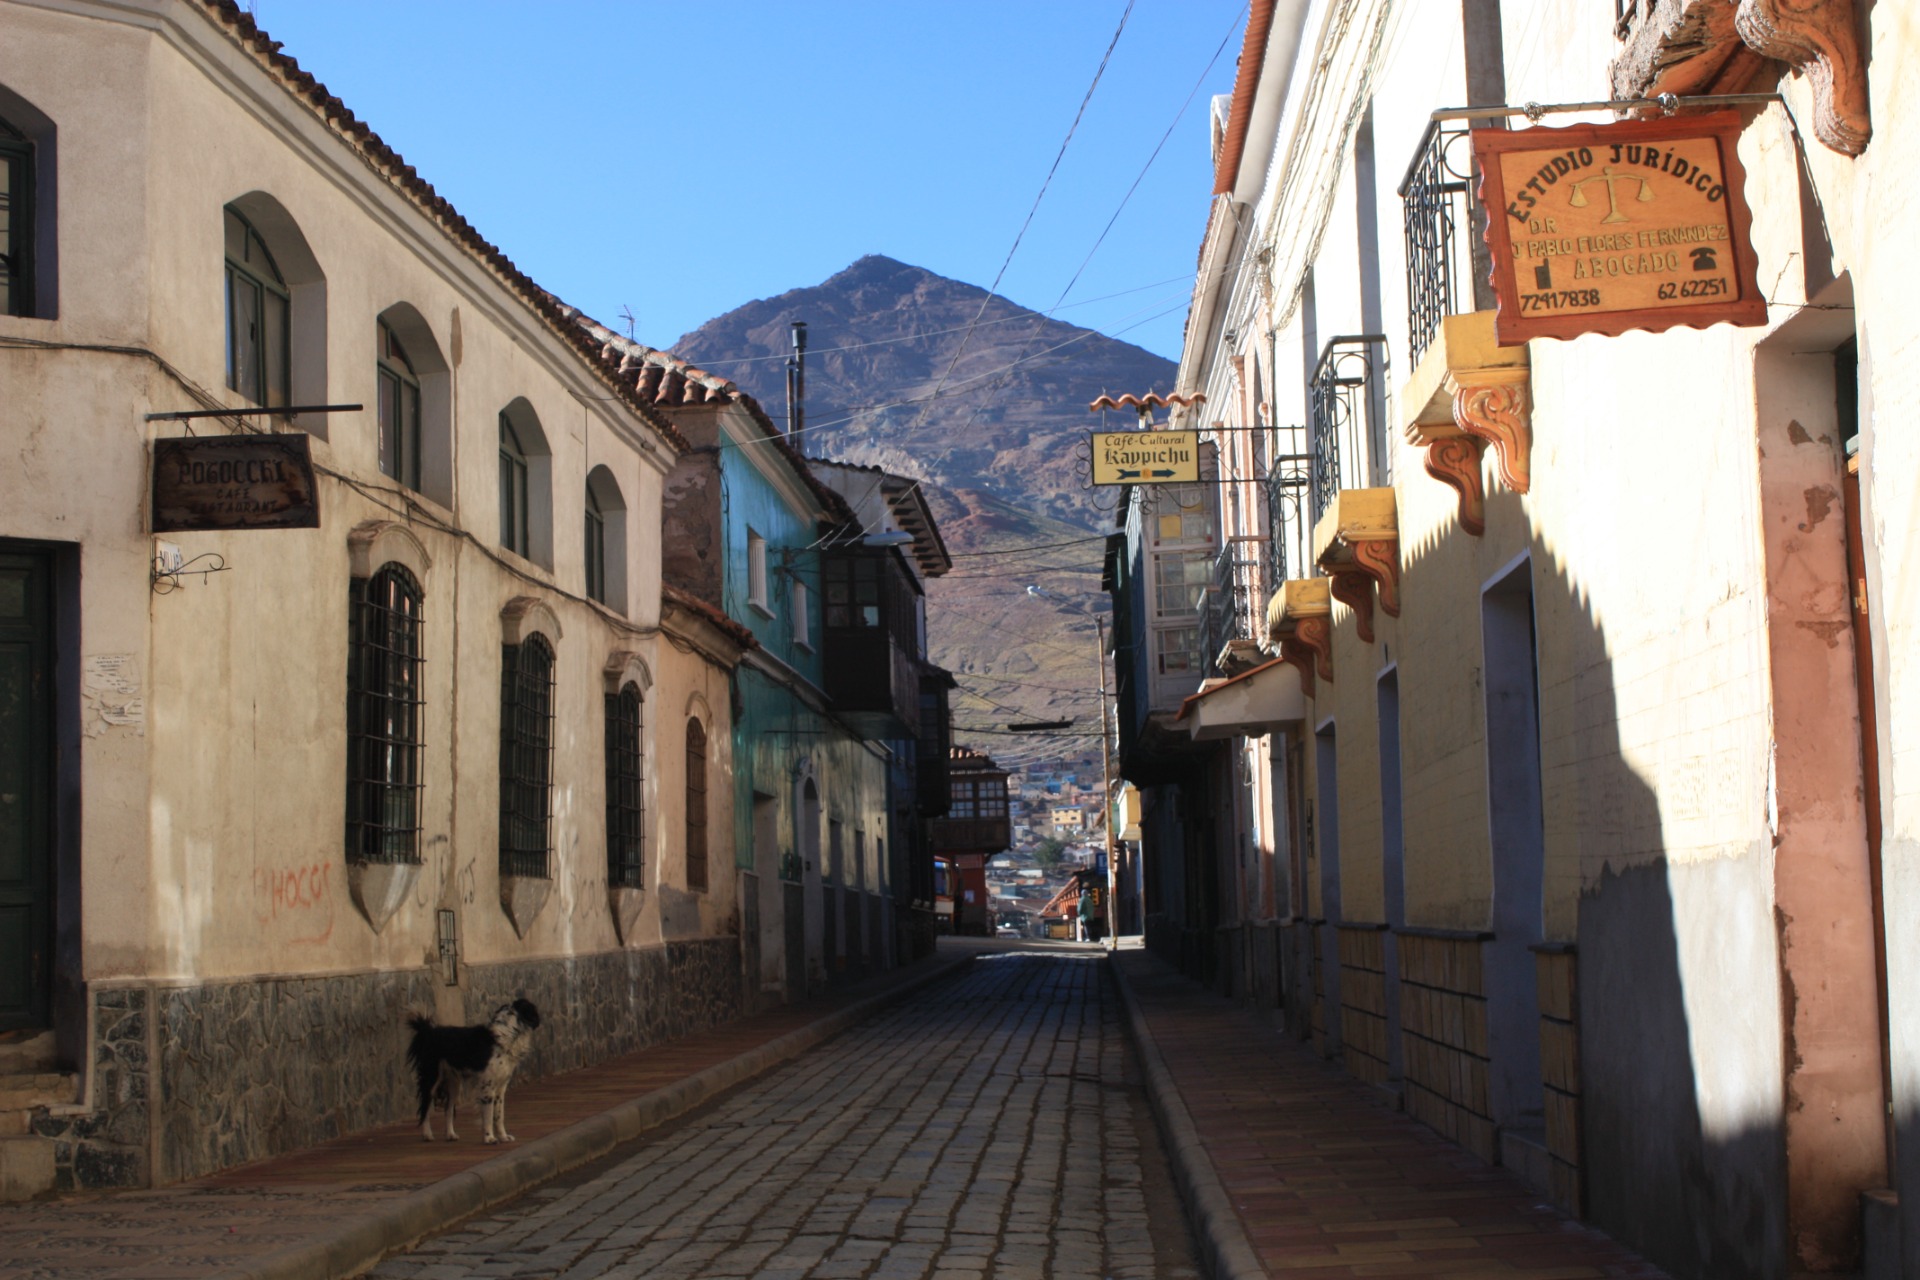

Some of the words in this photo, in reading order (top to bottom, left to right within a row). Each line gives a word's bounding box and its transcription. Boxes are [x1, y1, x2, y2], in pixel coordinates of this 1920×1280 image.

[1507, 147, 1593, 224] ESTUDIO
[1609, 143, 1725, 202] JURÍDICO
[1527, 239, 1573, 258] PABLO
[1578, 232, 1634, 253] FLORES
[1574, 251, 1680, 280] ABOGADO
[1520, 288, 1601, 312] 72417838
[1104, 447, 1190, 468] Kaypichu
